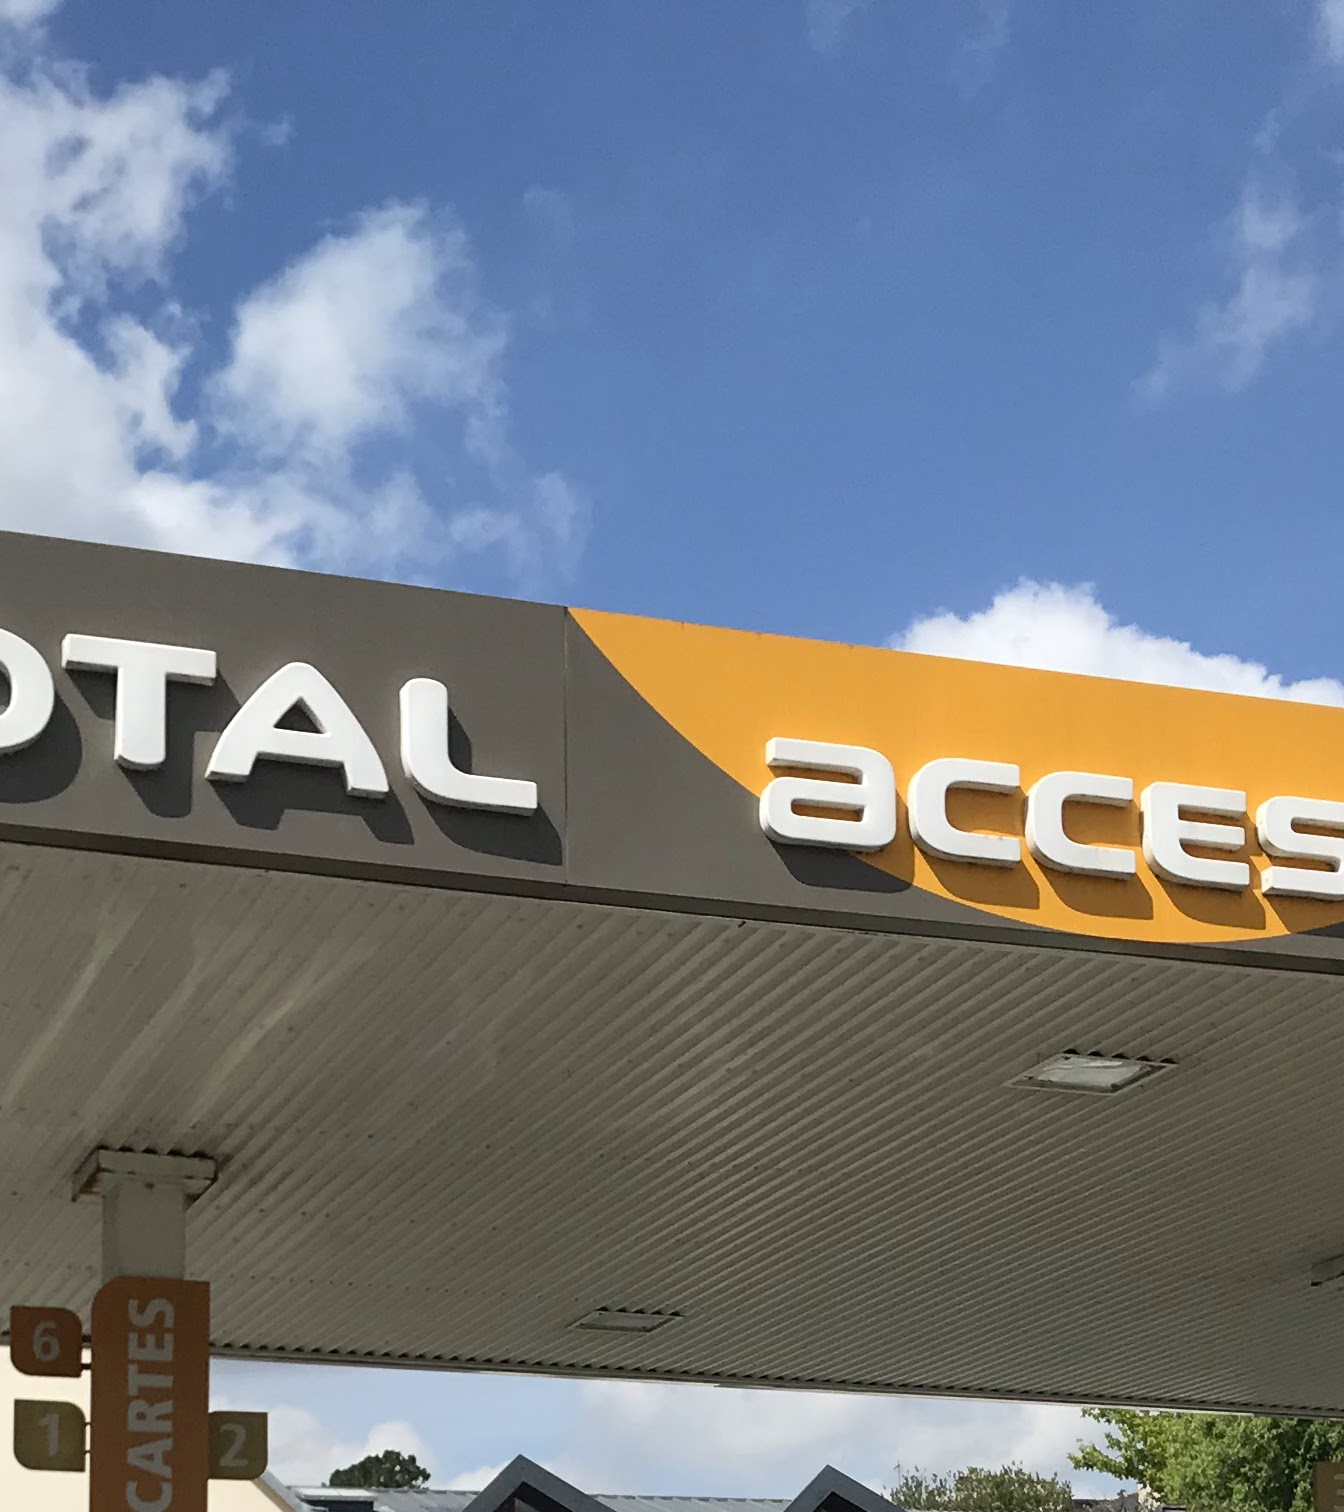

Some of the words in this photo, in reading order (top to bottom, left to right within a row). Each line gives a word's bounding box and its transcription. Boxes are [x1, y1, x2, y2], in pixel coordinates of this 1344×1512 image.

[32, 1321, 60, 1361] 6
[38, 1413, 58, 1456] 1
[219, 1422, 248, 1467] 2
